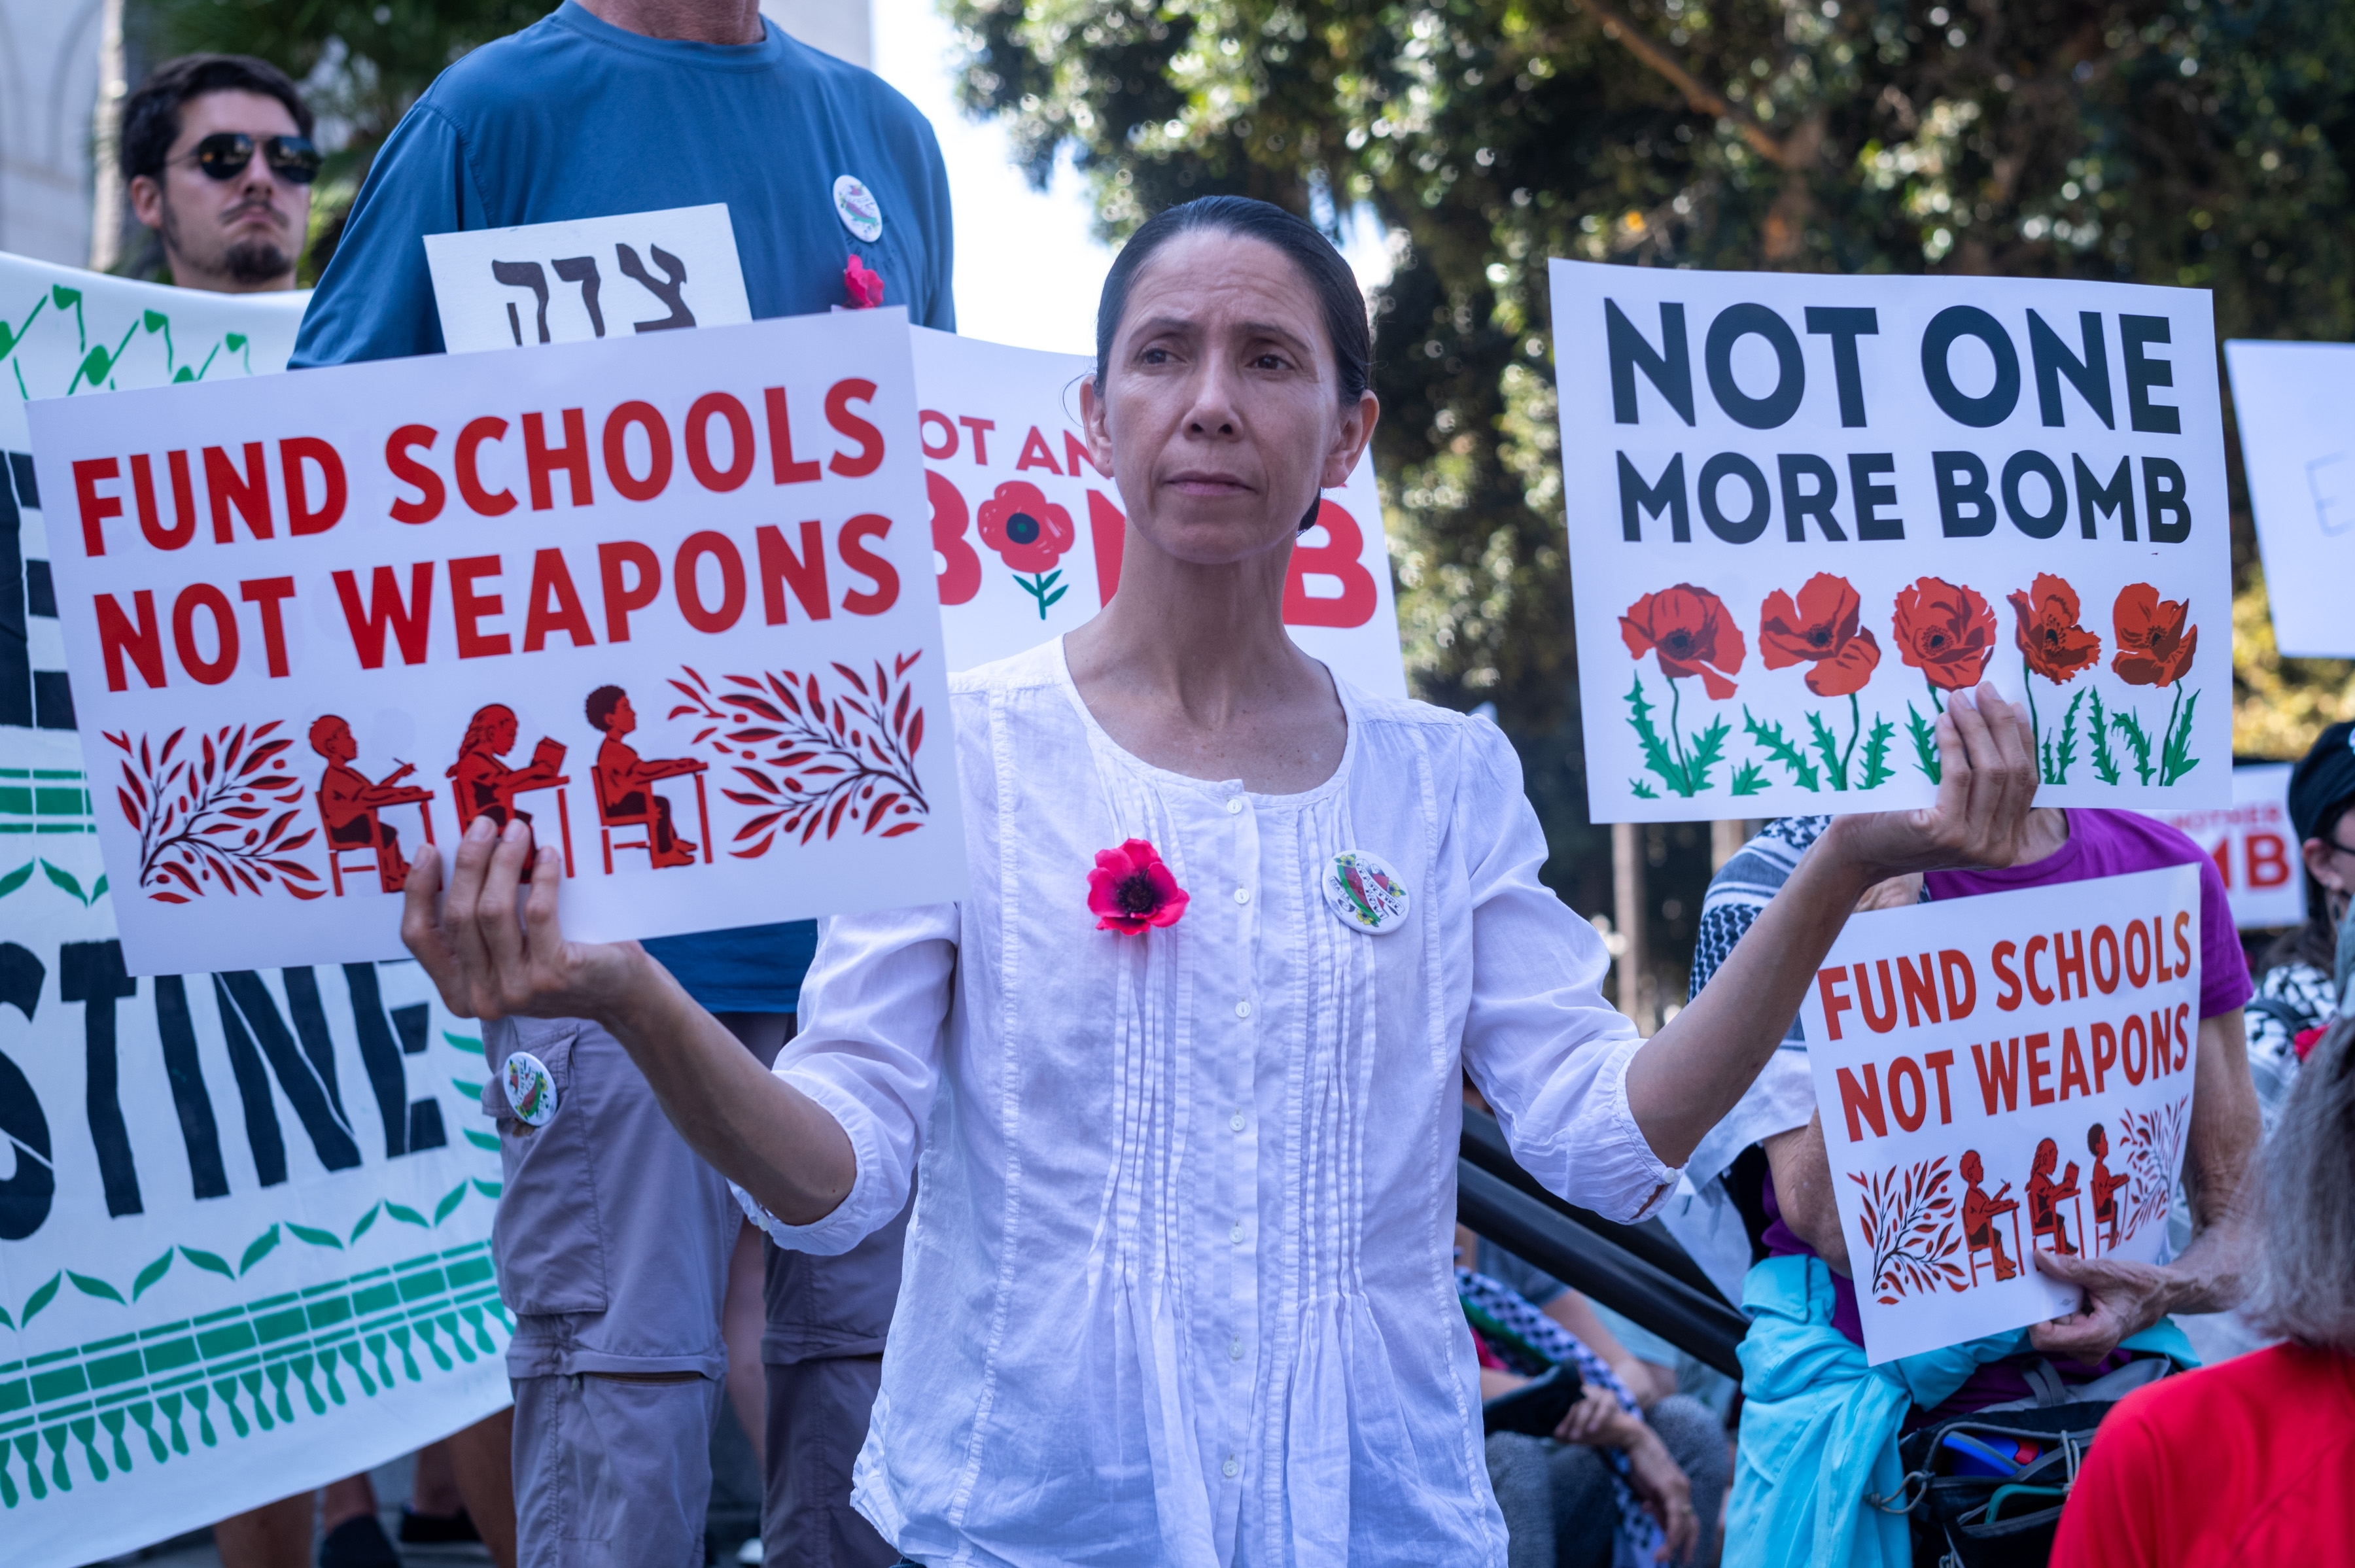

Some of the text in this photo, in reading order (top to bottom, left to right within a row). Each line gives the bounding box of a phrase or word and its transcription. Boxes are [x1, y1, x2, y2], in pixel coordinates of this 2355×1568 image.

[1604, 298, 2182, 434] NOT ONE
[71, 377, 885, 557] FUND SCHOOLS
[918, 409, 1110, 480] OT AN
[1616, 449, 2192, 545] MORE BOMB
[94, 513, 900, 693] NOT WEAPONS
[1356, 862, 1403, 912] CEASEFIRE
[1817, 910, 2191, 1041] FUND SCHOOLS
[1836, 1002, 2189, 1142] NOT WEAPONS
